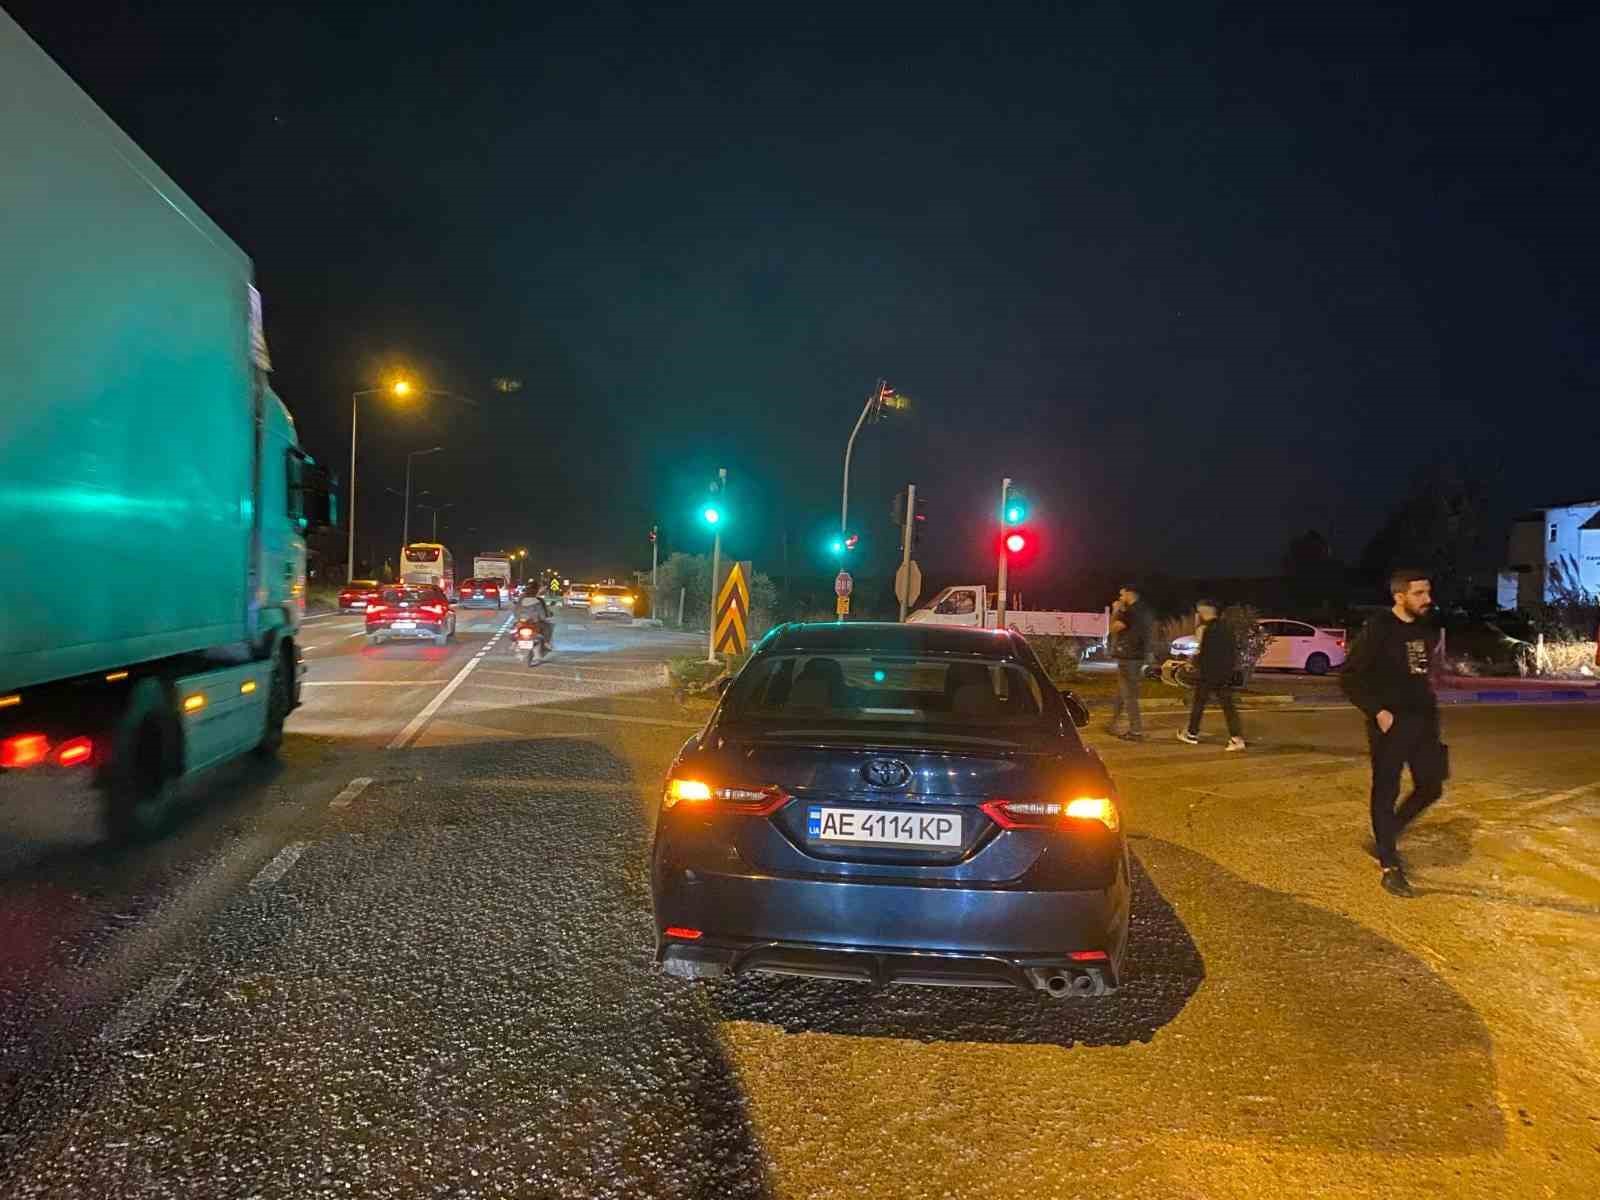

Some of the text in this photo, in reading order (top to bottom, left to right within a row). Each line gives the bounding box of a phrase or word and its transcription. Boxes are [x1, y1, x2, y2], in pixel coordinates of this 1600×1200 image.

[809, 826, 820, 834] UA
[822, 812, 952, 840] AE 4114 KP
